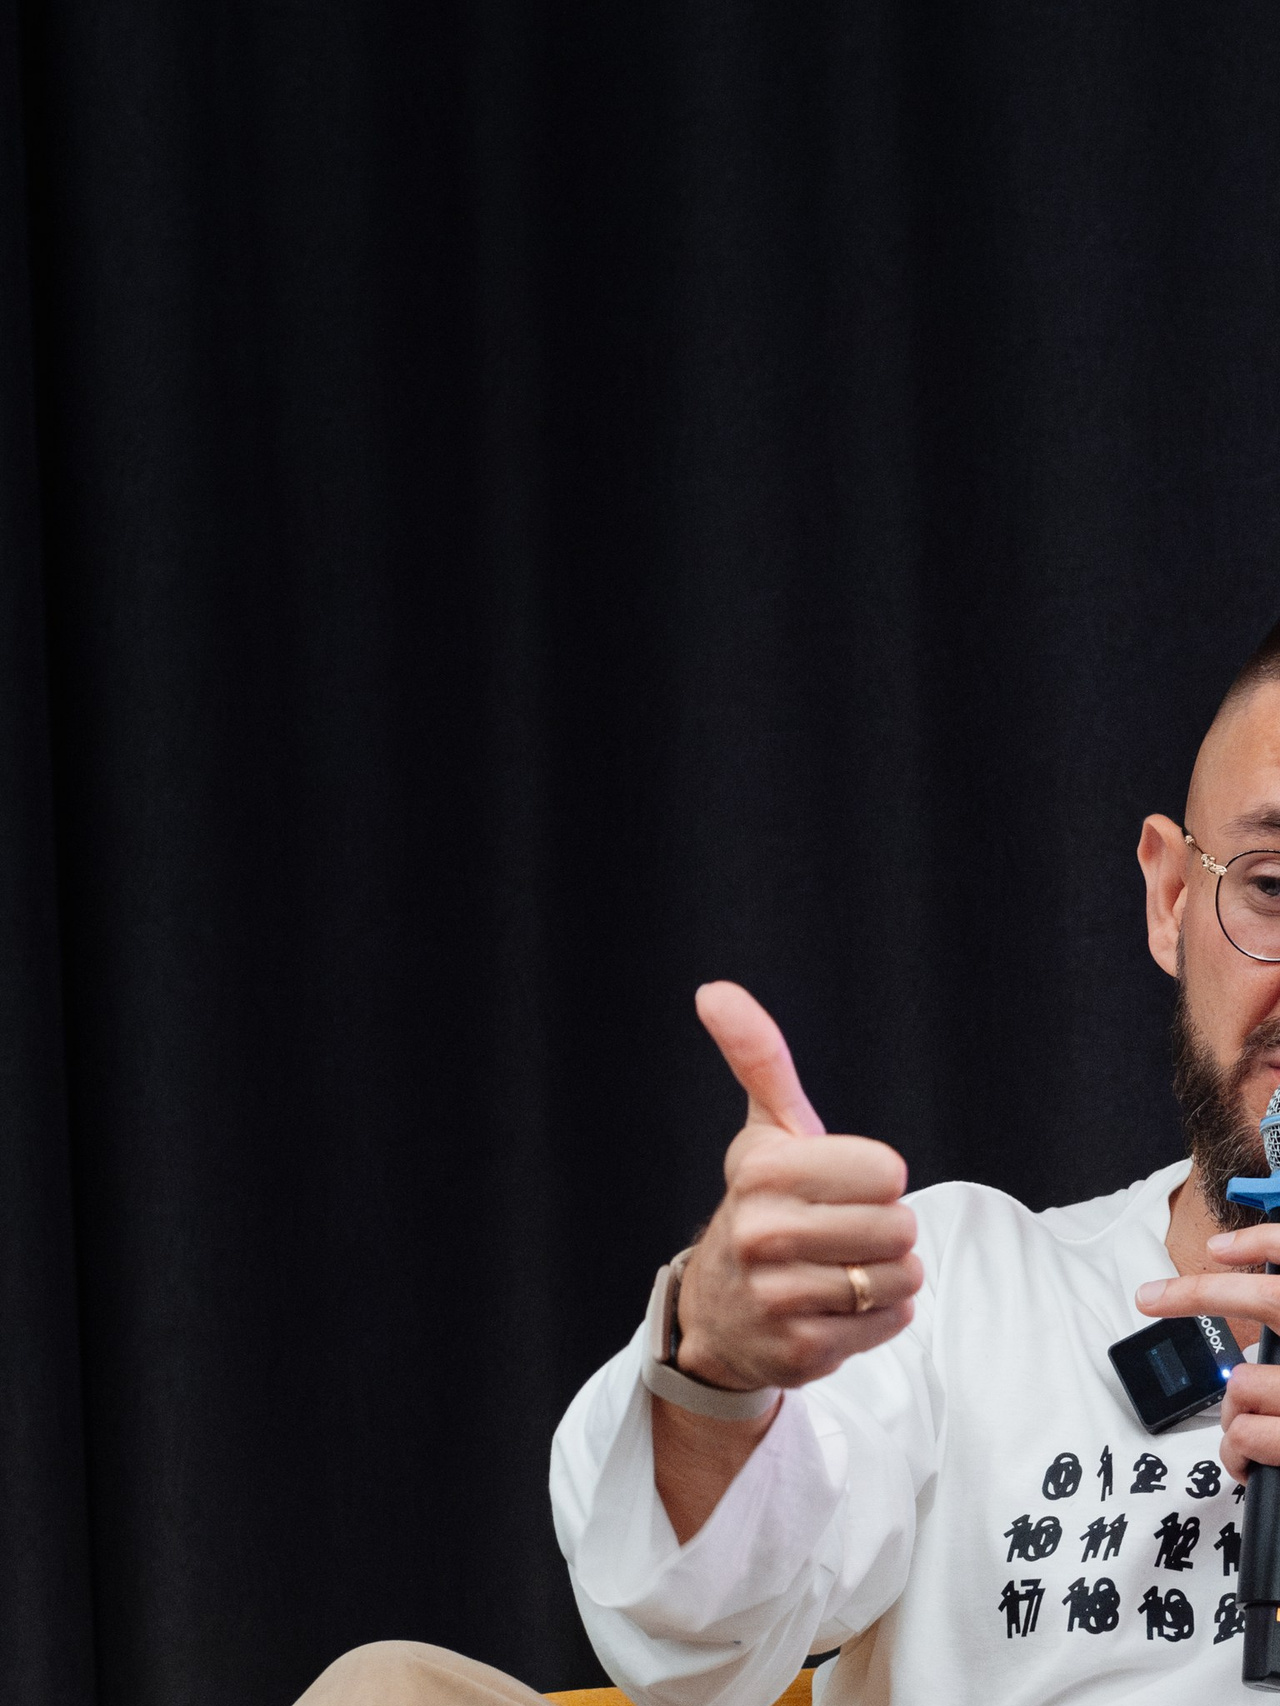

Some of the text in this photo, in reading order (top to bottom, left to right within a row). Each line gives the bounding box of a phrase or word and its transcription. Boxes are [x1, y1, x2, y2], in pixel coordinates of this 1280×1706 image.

[1197, 1314, 1226, 1354] odox
[1096, 1444, 1113, 1502] 1
[1130, 1452, 1168, 1495] 2
[1185, 1460, 1222, 1499] 3
[1079, 1513, 1129, 1563] 11
[998, 1578, 1046, 1639] 17
